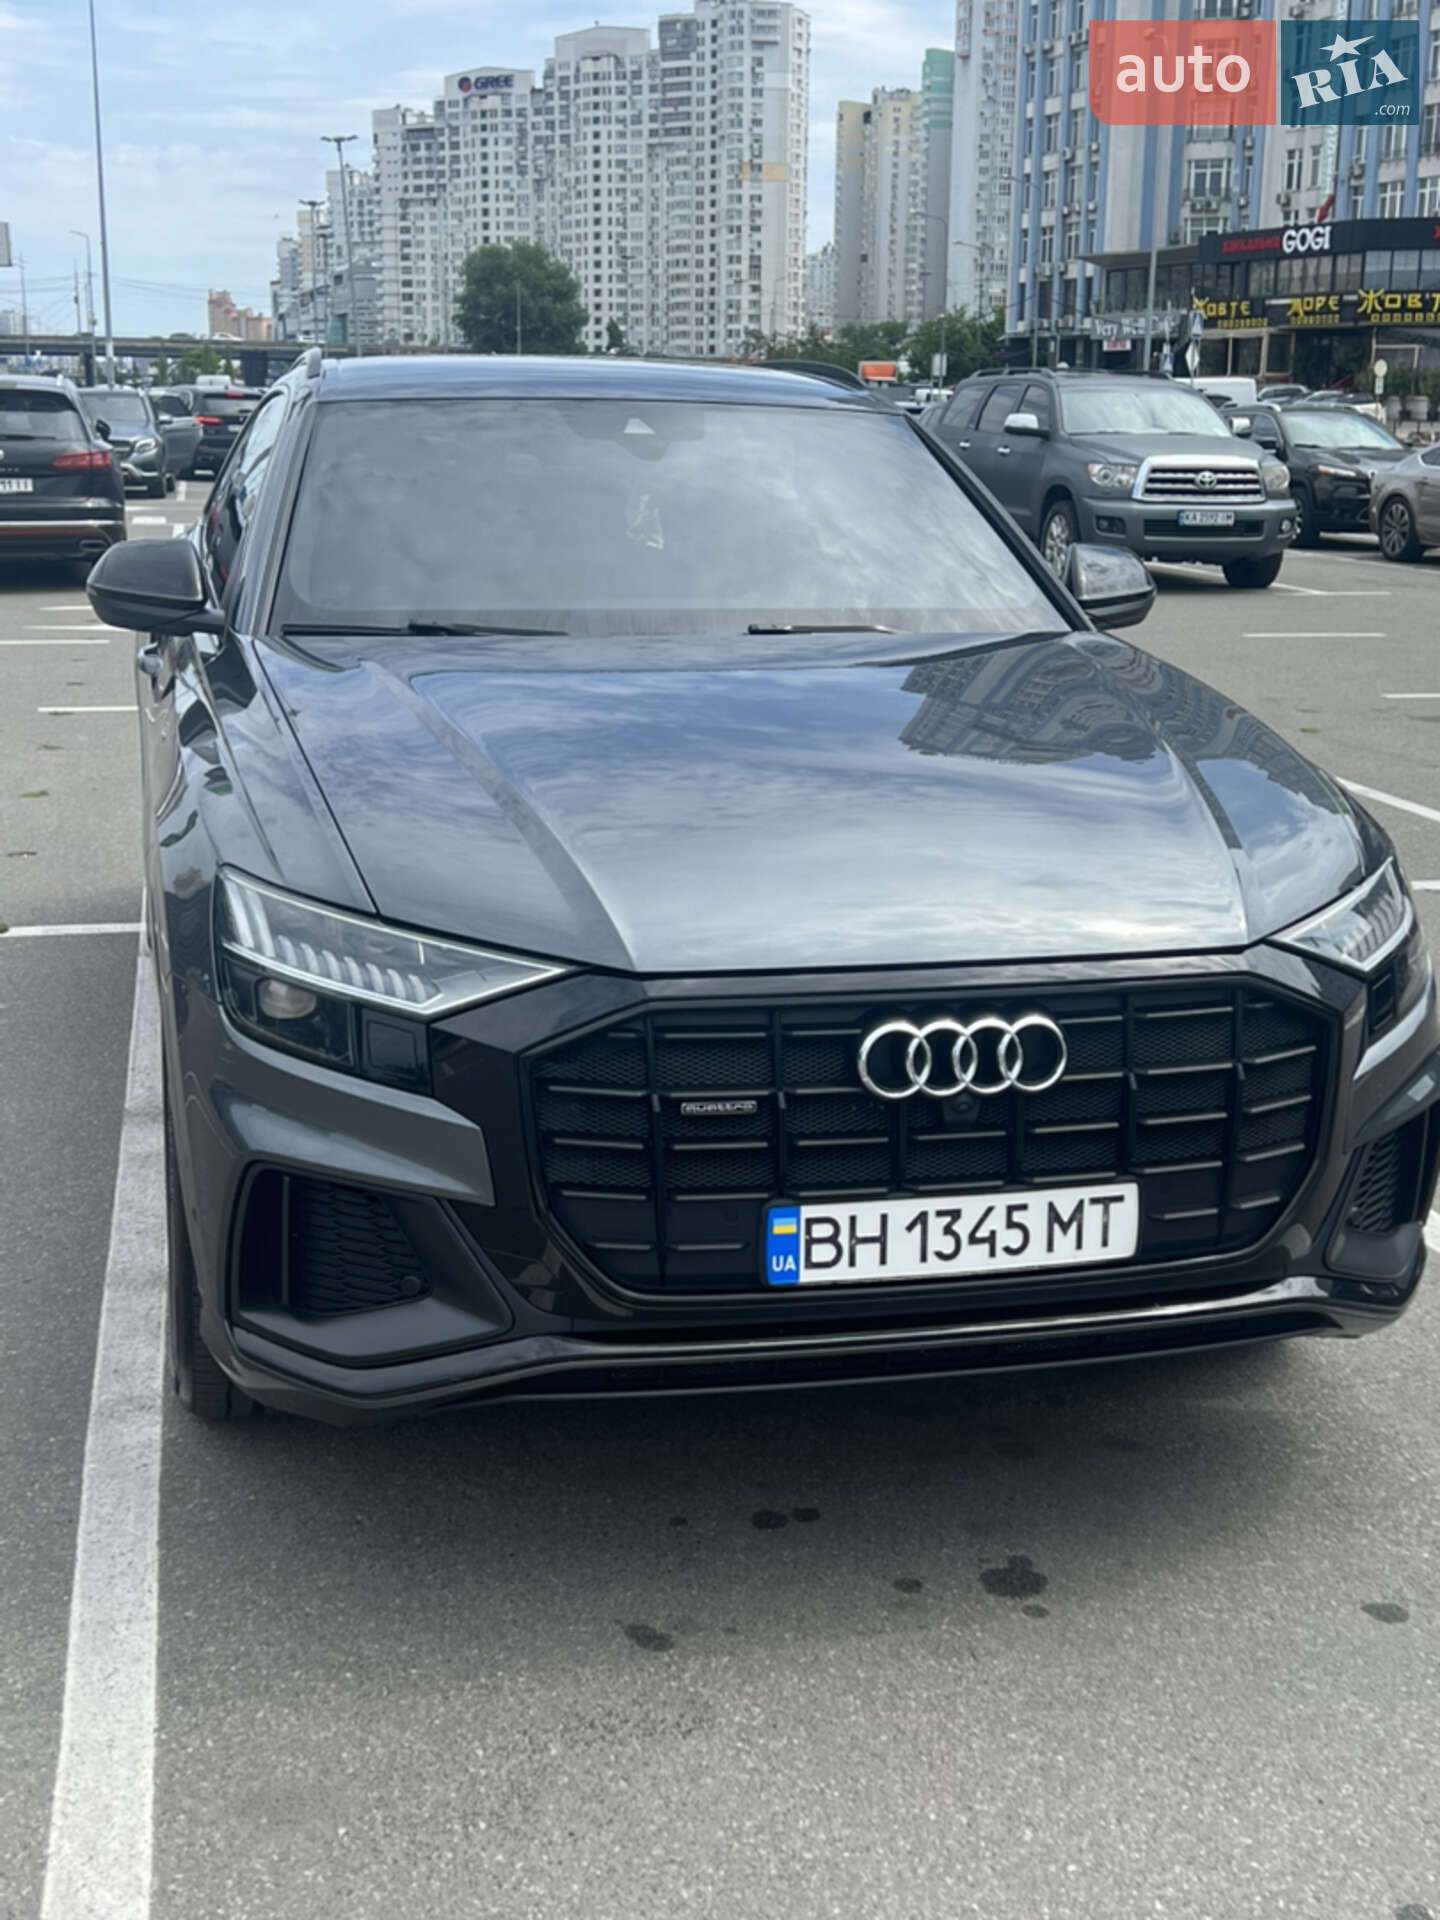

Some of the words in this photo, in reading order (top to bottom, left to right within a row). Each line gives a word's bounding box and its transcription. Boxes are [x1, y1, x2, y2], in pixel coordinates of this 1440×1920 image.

[474, 74, 514, 89] GREE
[1282, 226, 1331, 254] GOGI
[804, 1212, 888, 1270] BH
[905, 1203, 1030, 1263] 1345
[1046, 1194, 1125, 1253] MT
[772, 1255, 797, 1272] UA
